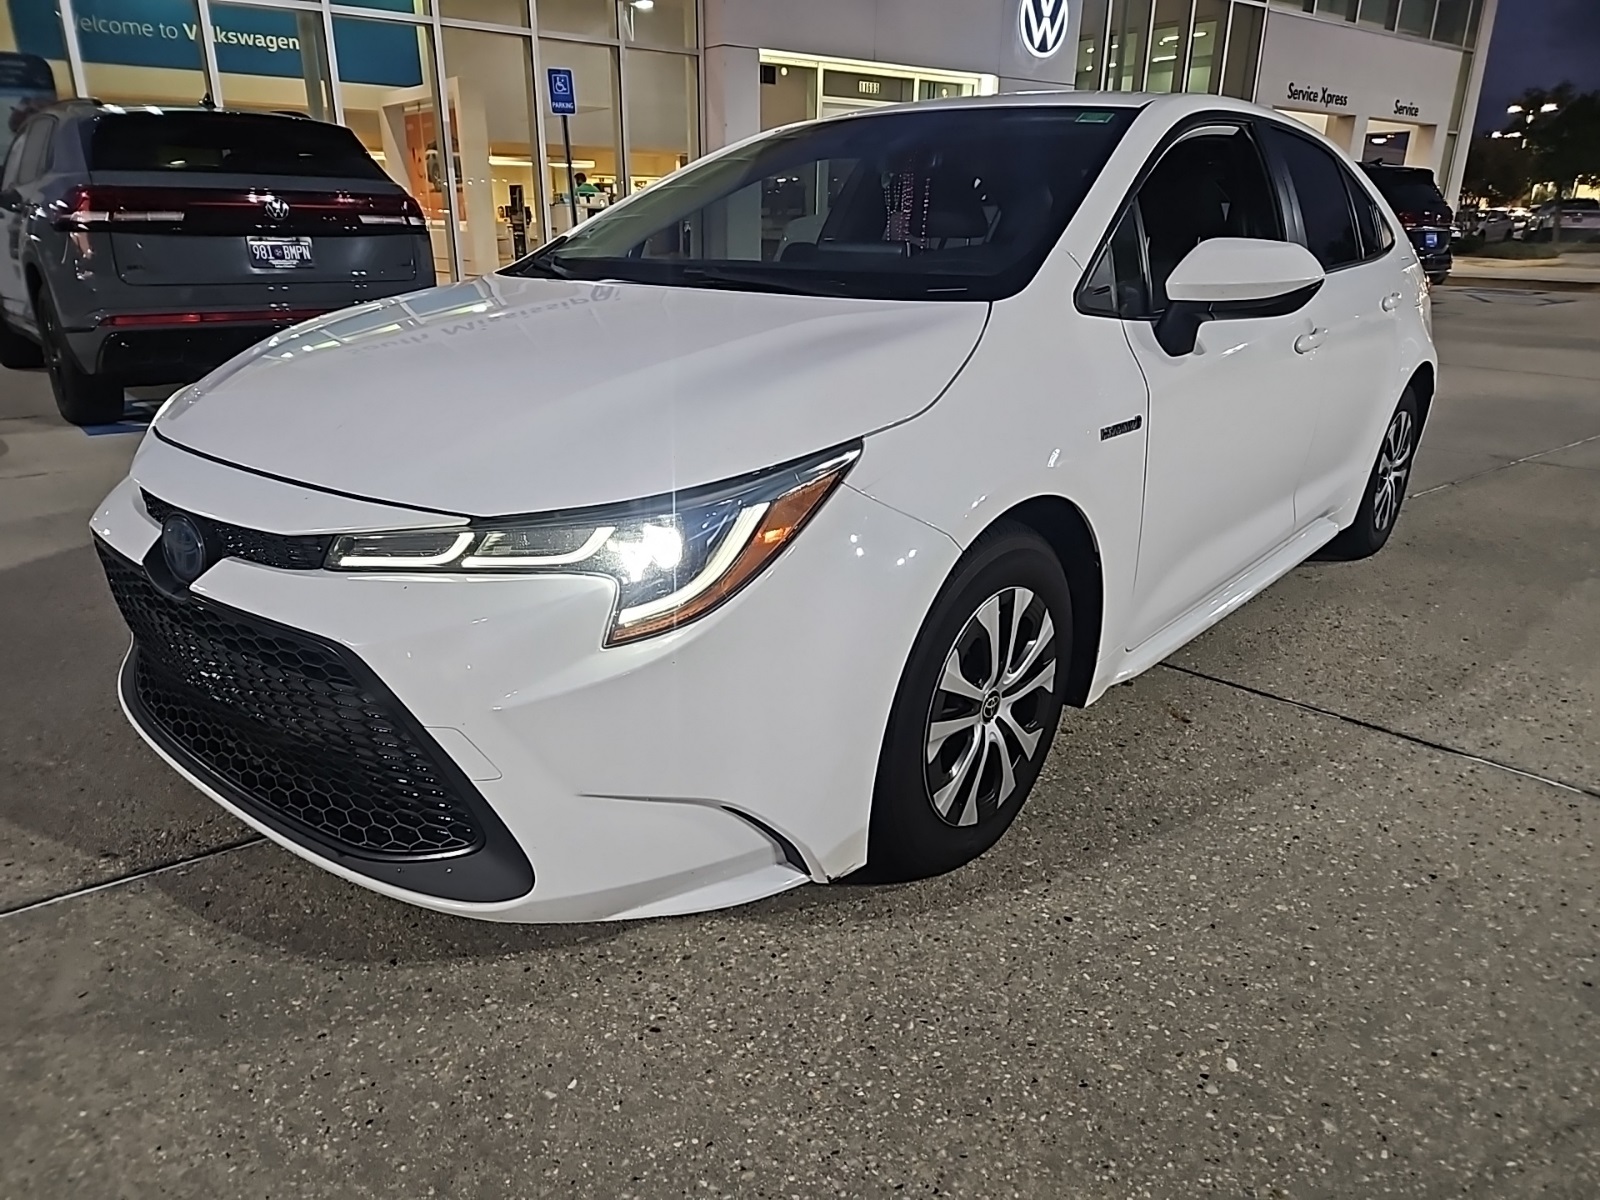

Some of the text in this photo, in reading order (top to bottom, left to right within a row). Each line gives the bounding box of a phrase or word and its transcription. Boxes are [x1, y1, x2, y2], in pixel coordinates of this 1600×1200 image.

[56, 11, 300, 51] elcome to Vlkswagen
[1287, 82, 1348, 107] Service Xpress
[552, 101, 574, 109] PARKING
[1393, 99, 1419, 117] Service
[252, 245, 311, 260] 981 BMPN
